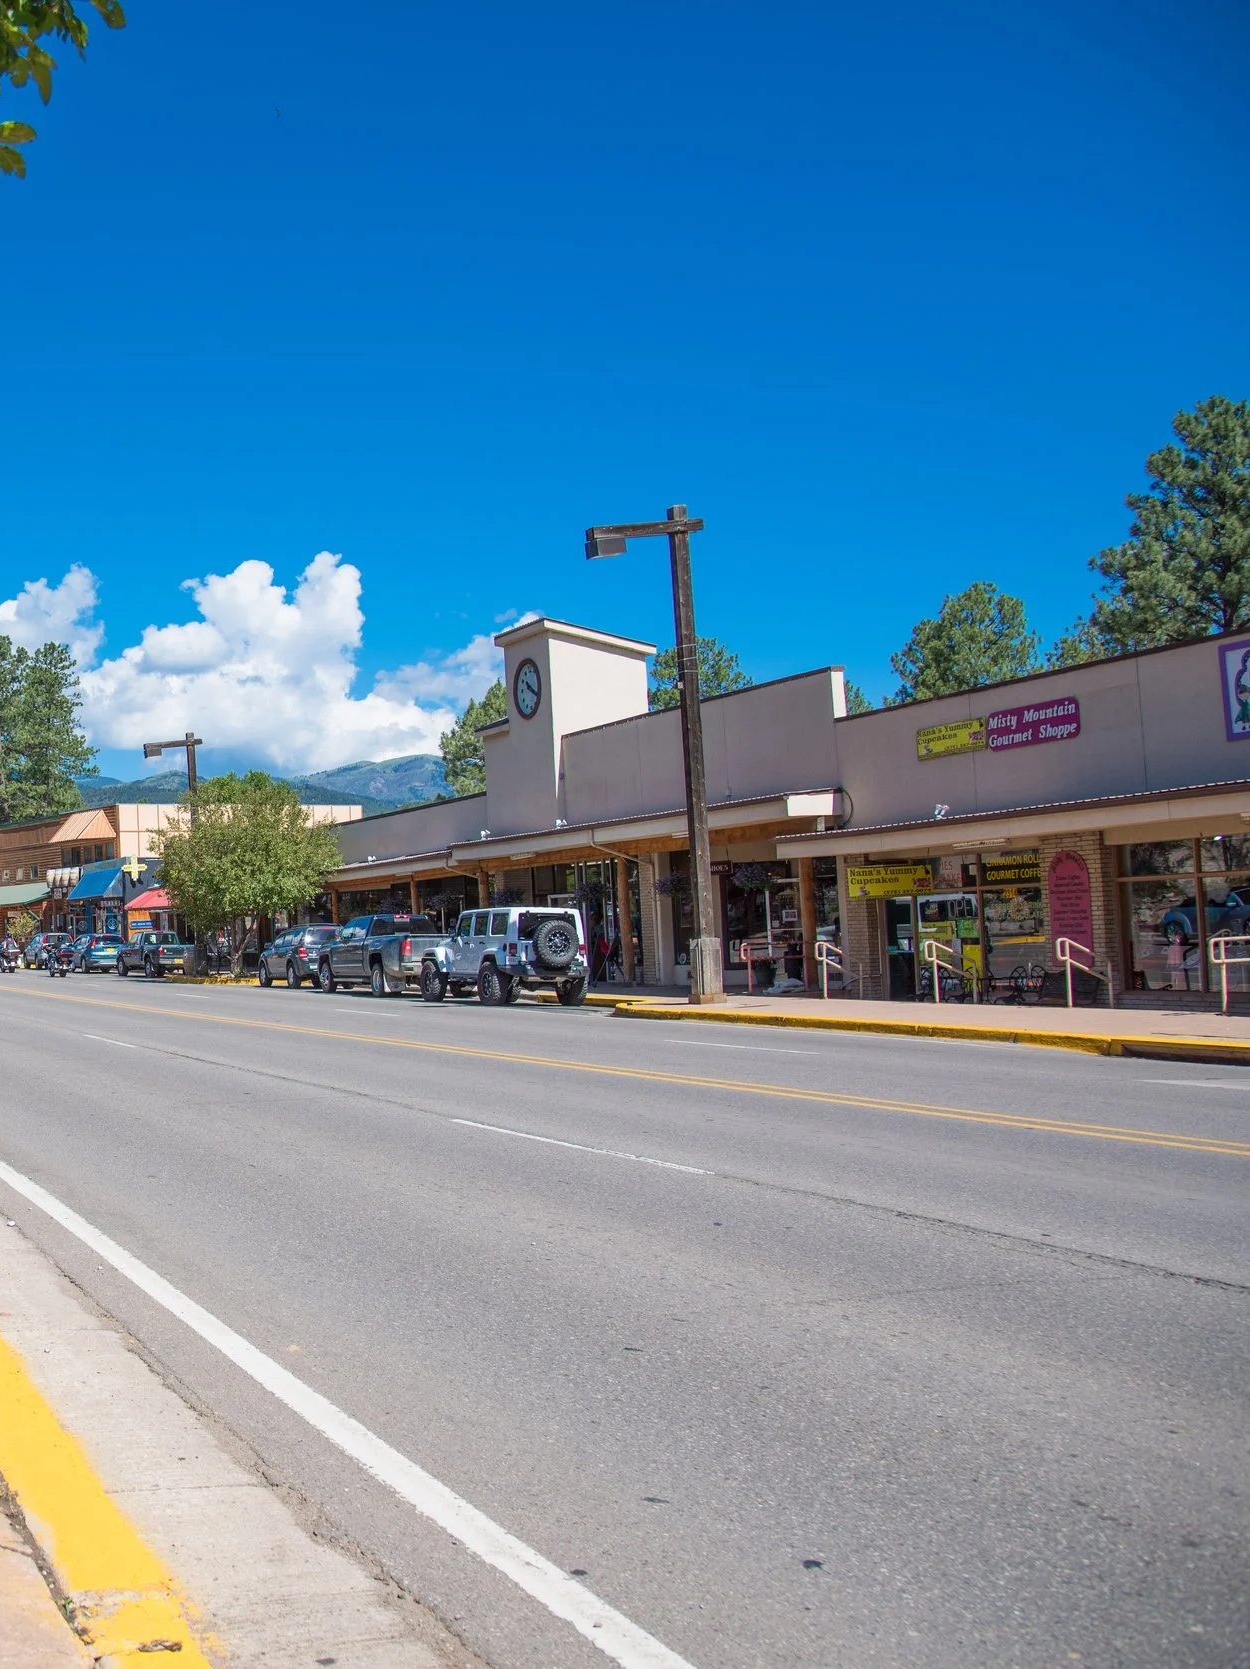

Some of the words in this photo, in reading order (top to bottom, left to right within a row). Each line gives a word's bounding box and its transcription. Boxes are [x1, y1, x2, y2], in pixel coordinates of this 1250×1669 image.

[988, 714, 1017, 730] Misty
[1022, 701, 1076, 723] Mountain
[917, 726, 942, 739] Nana's
[943, 721, 974, 733] Yummy
[989, 730, 1033, 748] Gourmet
[1039, 722, 1078, 739] Shoppe
[917, 732, 958, 746] Cupcakes
[985, 855, 1023, 867] CINNAMON
[850, 868, 881, 878] Nana's
[883, 867, 918, 876] Yummy
[986, 869, 1019, 881] GOURMET
[850, 876, 899, 886] Cupcakes
